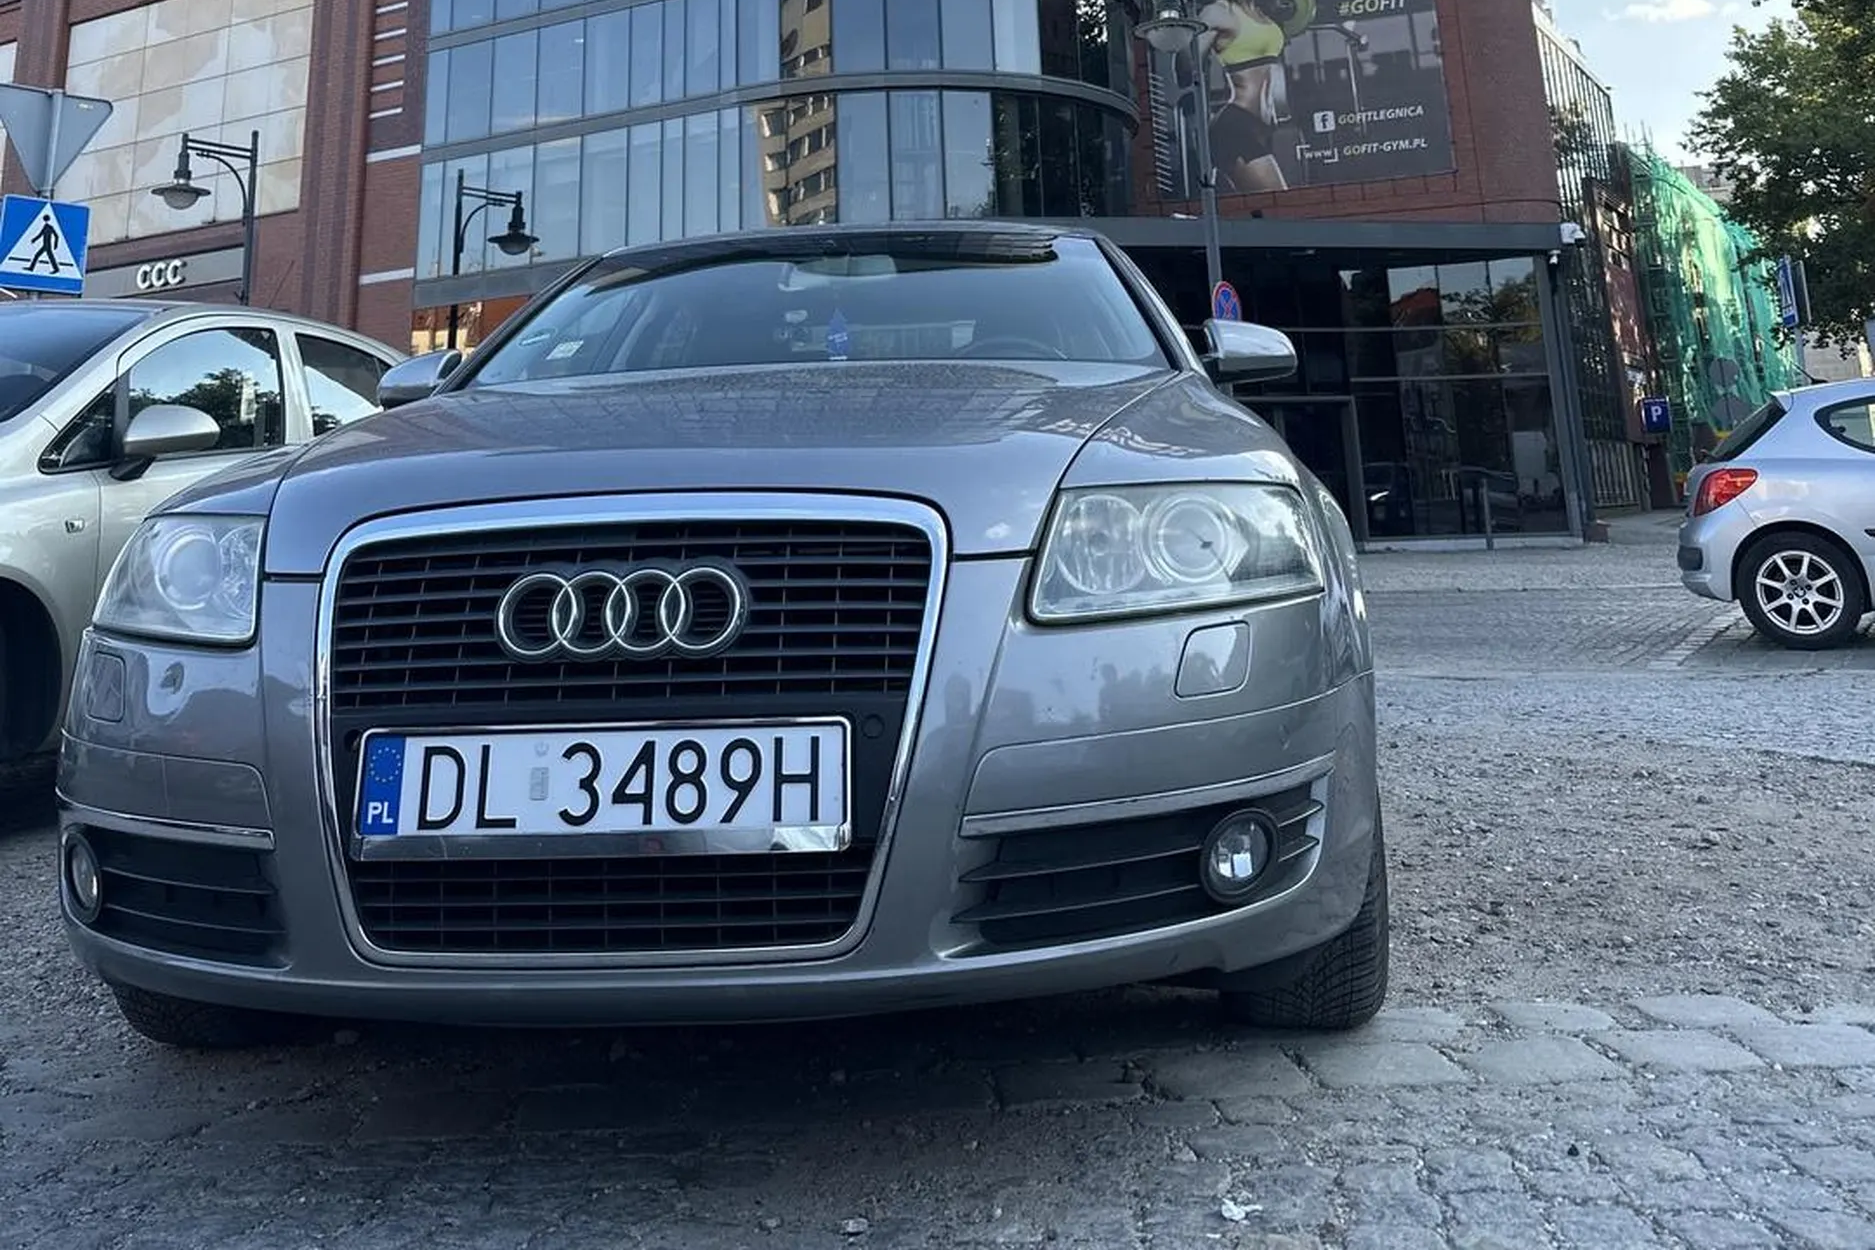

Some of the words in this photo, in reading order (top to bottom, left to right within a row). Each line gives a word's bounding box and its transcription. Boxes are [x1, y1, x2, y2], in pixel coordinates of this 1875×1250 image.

[1338, 105, 1424, 125] GOFITLEGNICA
[1343, 138, 1428, 156] GOFIT-GYM.PL
[136, 259, 183, 290] CCC
[1651, 405, 1663, 422] P
[416, 743, 517, 831] DL
[558, 735, 821, 827] 3489H
[367, 801, 395, 826] PL
